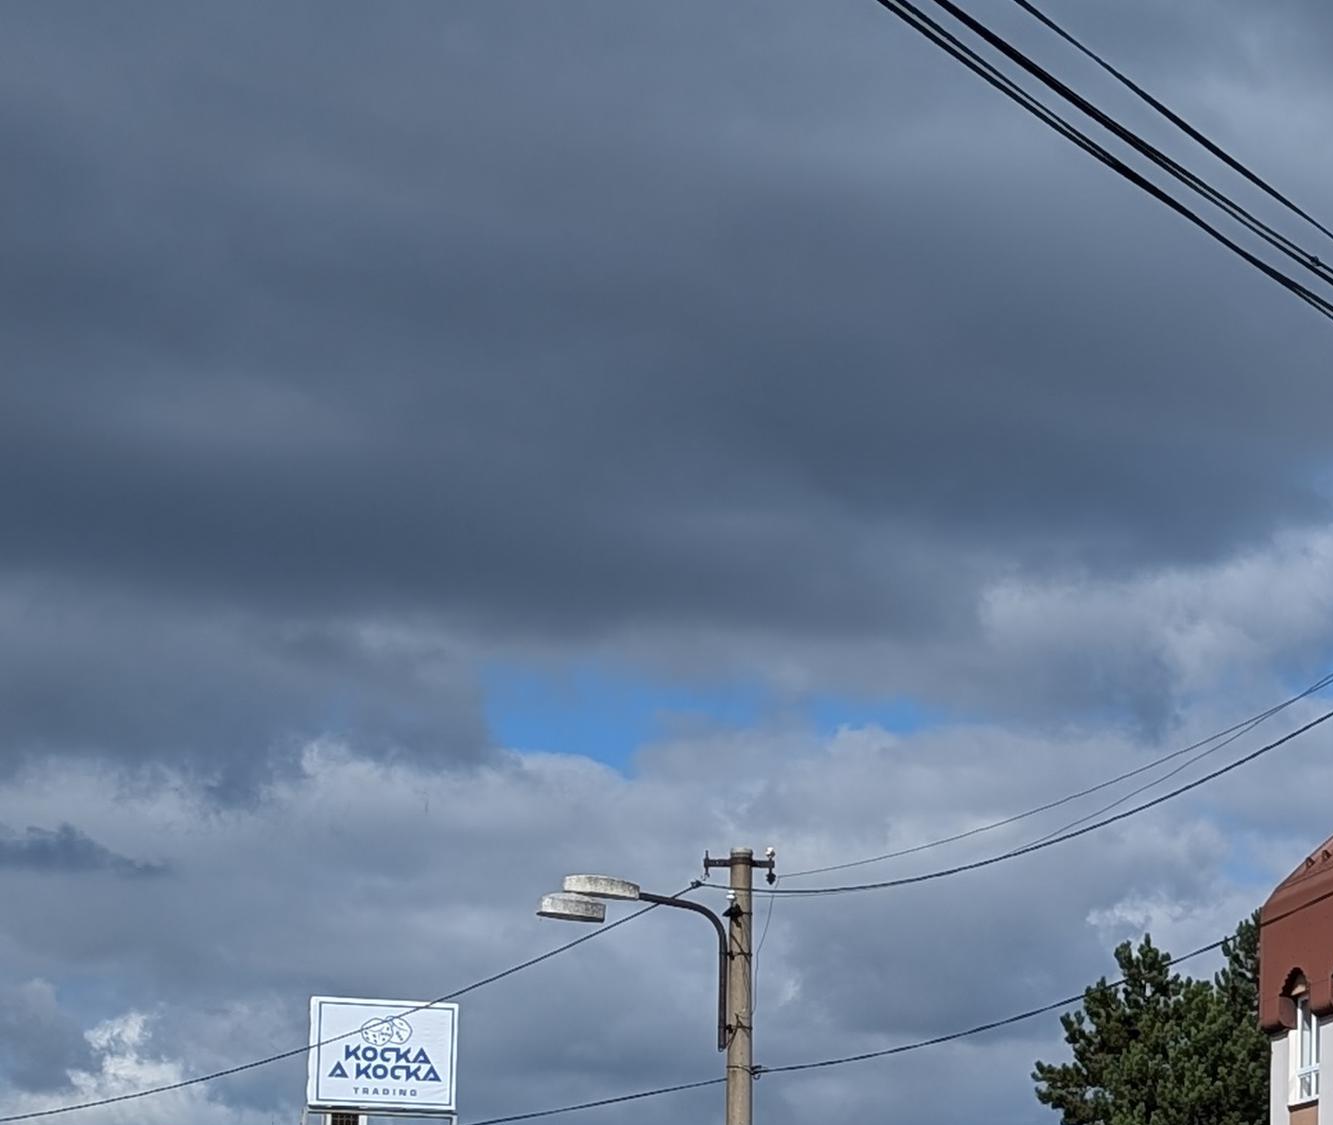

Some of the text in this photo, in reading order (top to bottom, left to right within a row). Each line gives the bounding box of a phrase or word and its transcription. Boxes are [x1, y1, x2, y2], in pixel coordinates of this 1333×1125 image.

[344, 1043, 432, 1065] KOCKA
[328, 1060, 442, 1082] A KOCKA
[353, 1086, 418, 1097] TRADING
